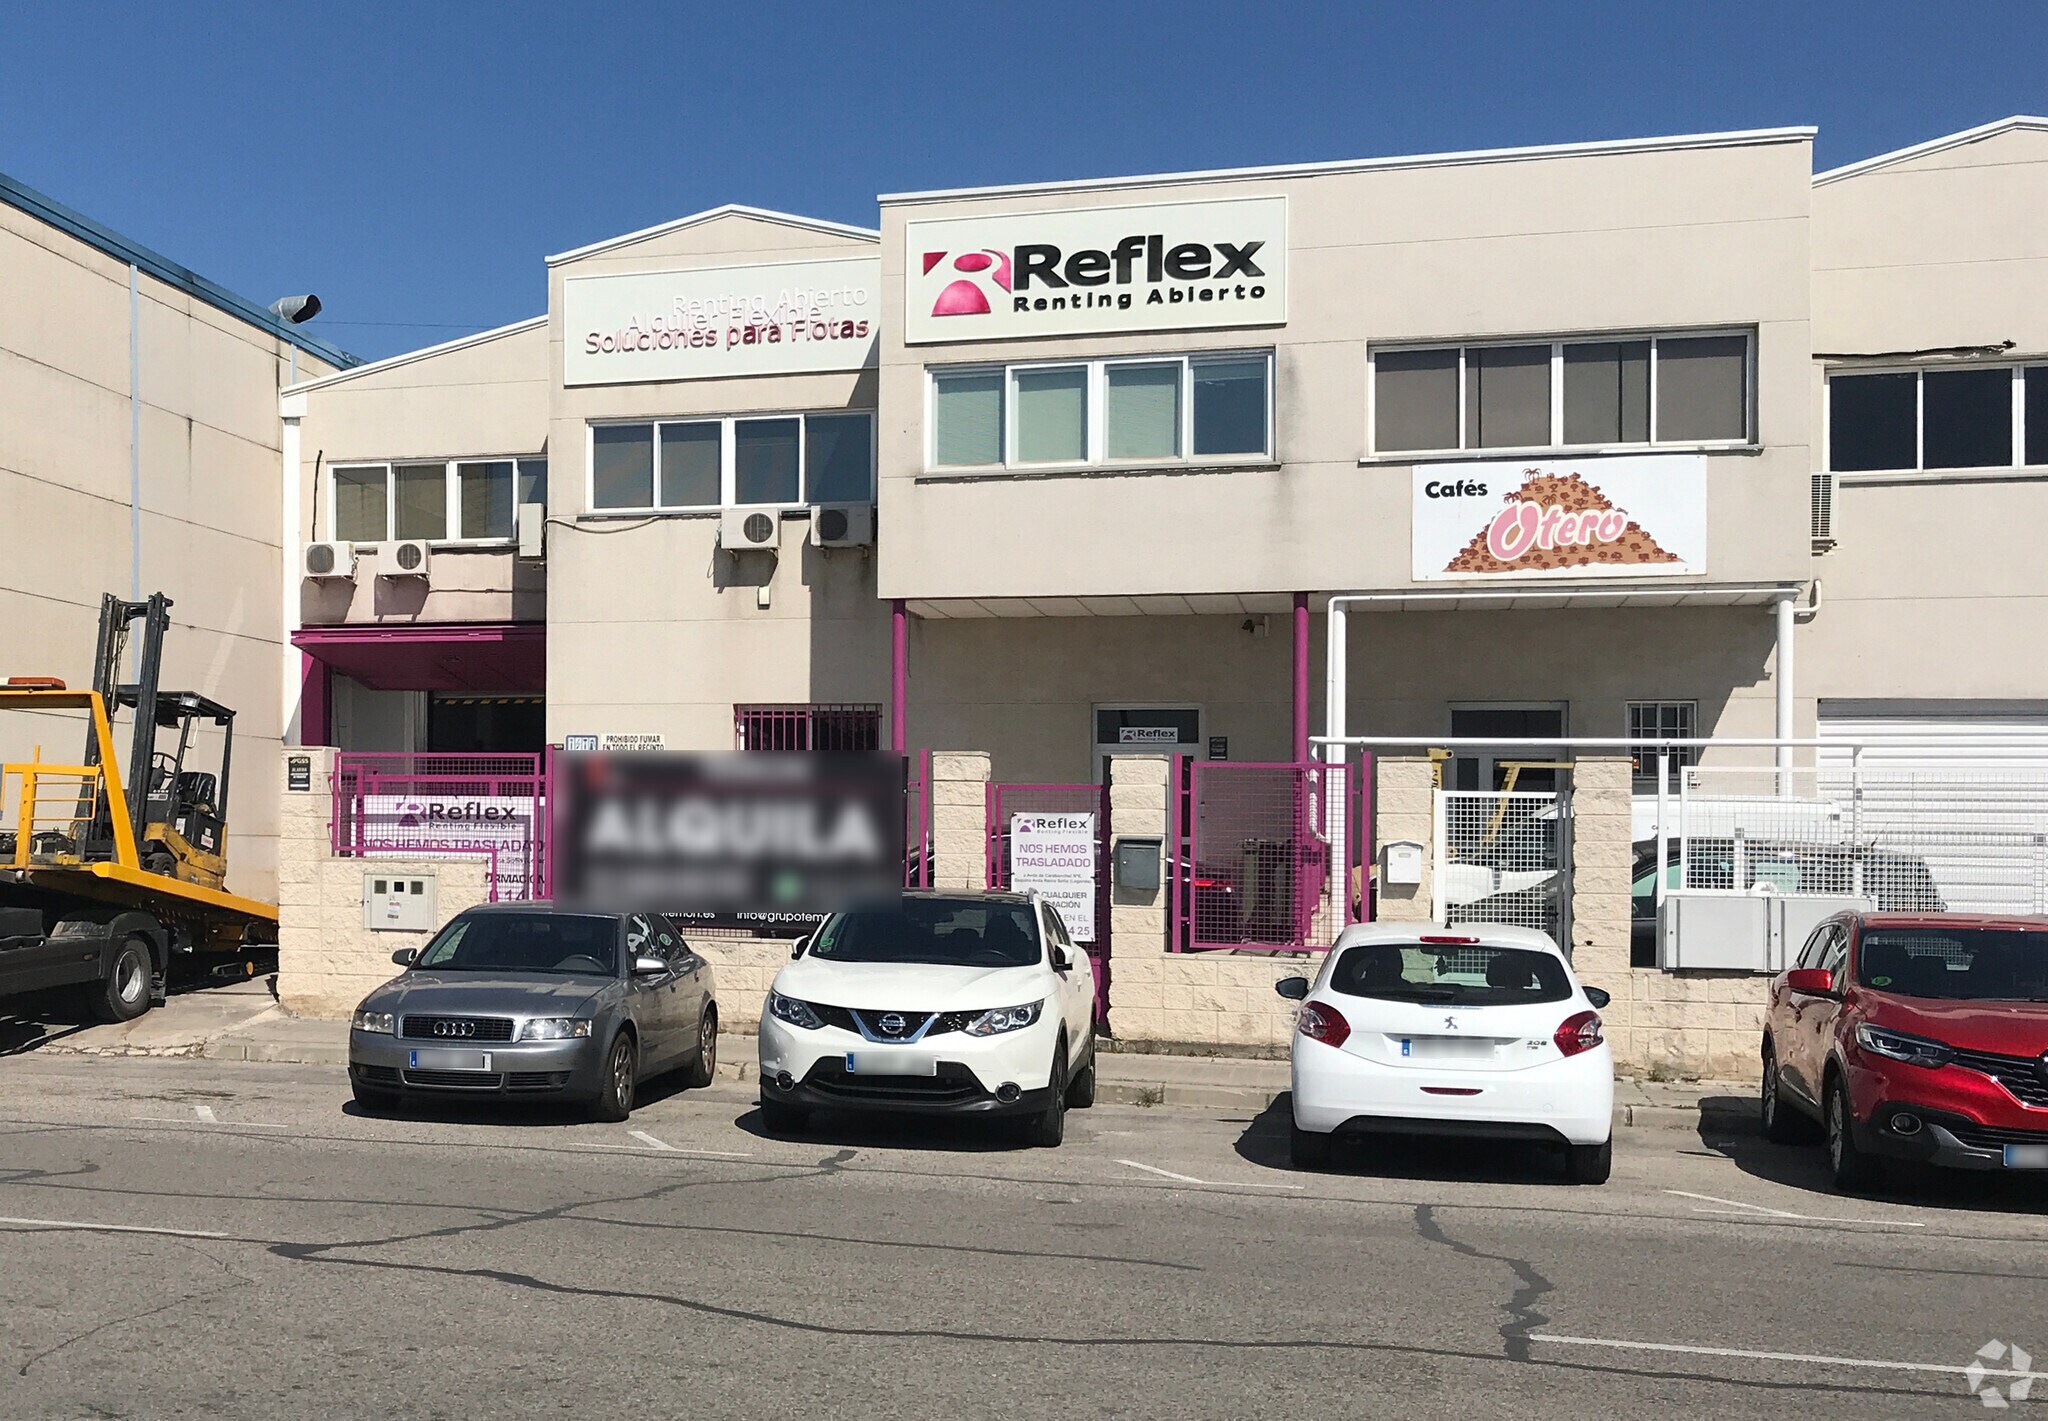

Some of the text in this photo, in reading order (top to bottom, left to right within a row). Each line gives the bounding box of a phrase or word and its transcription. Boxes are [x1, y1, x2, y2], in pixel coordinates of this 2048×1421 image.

[1014, 234, 1266, 291] Reflex
[673, 285, 868, 315] Renting Abierto
[1013, 284, 1266, 313] Renting Abierto
[585, 317, 869, 354] Soluciones para Flotas
[1425, 478, 1489, 498] Cafés
[1487, 500, 1628, 561] Otero
[606, 735, 661, 744] PROHIBIDO FUMAR
[1137, 729, 1176, 738] Reflex
[428, 802, 517, 821] Reflex
[429, 822, 518, 831] Renting Flexible
[1036, 818, 1088, 829] Reflex
[1019, 844, 1087, 854] NOS HEMOS
[1015, 858, 1091, 868] TRASLADADO
[1077, 926, 1091, 936] 25
